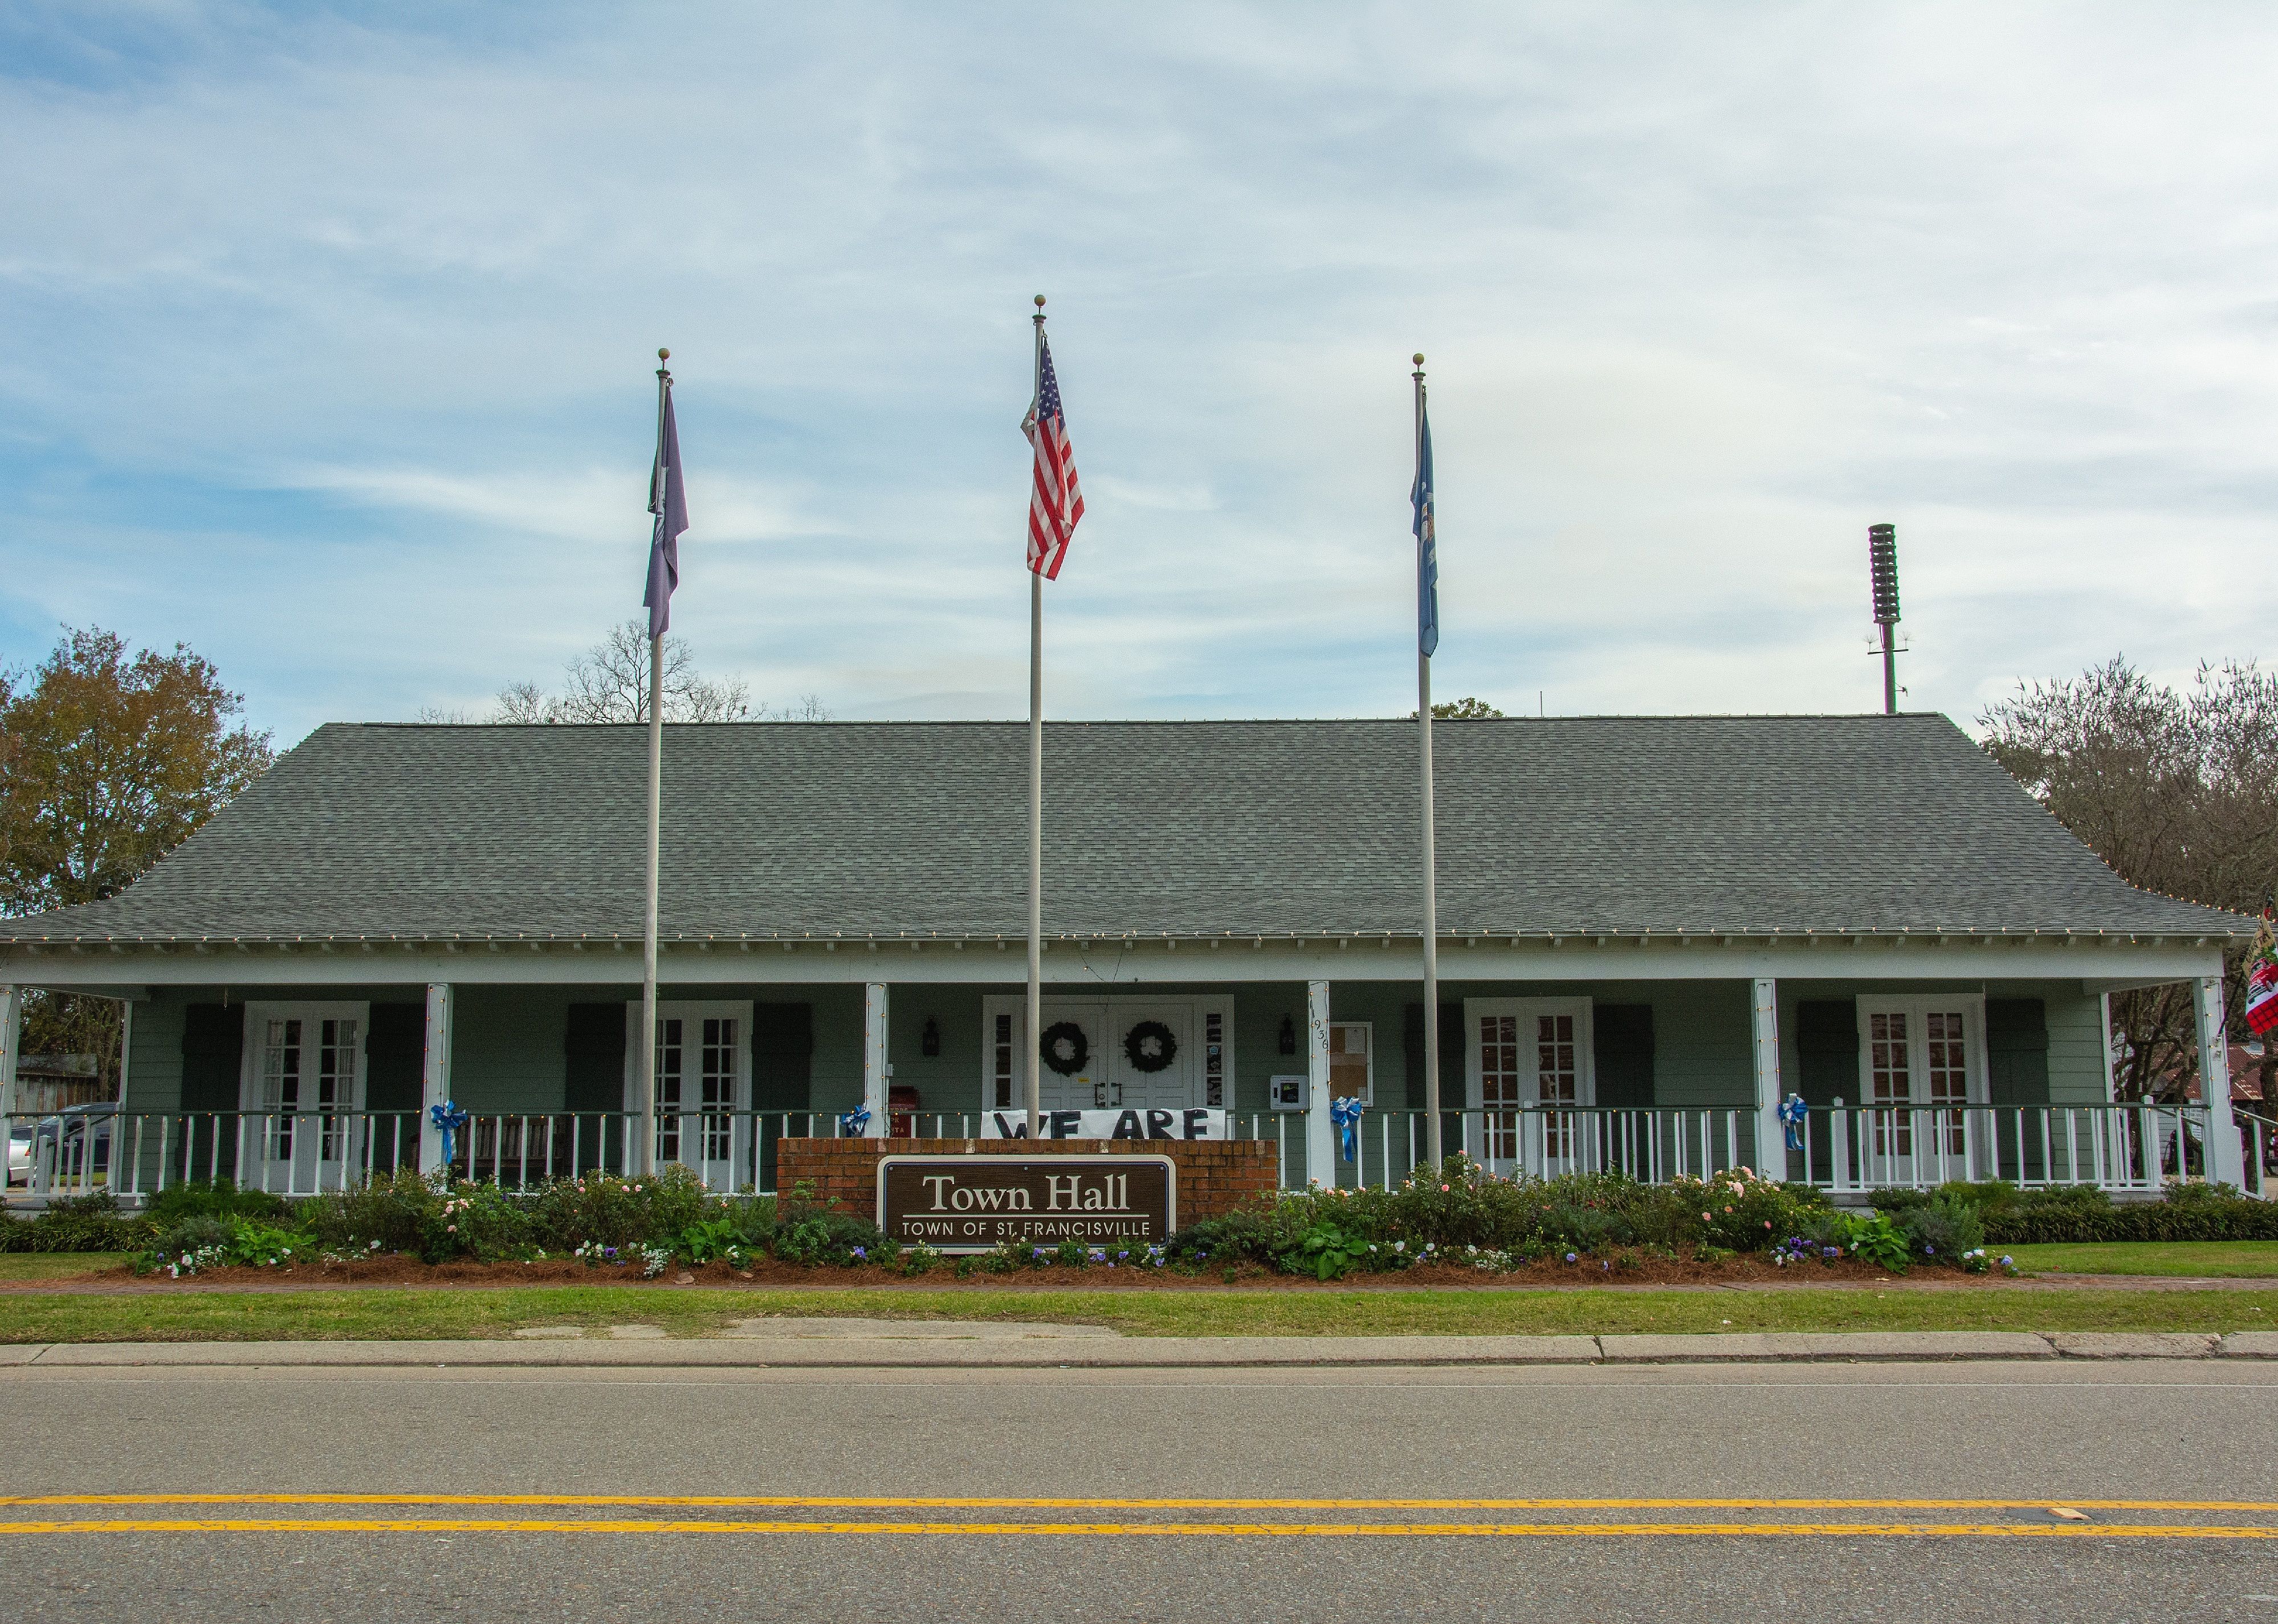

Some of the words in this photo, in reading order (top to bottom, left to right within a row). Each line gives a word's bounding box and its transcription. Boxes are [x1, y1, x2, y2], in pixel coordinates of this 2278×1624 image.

[923, 1176, 1032, 1210] Town
[1046, 1174, 1130, 1210] Hall
[903, 1222, 953, 1235] TOWN
[963, 1222, 987, 1235] OF
[997, 1222, 1017, 1235] ST.
[1024, 1222, 1150, 1235] FRANCISVILLE
